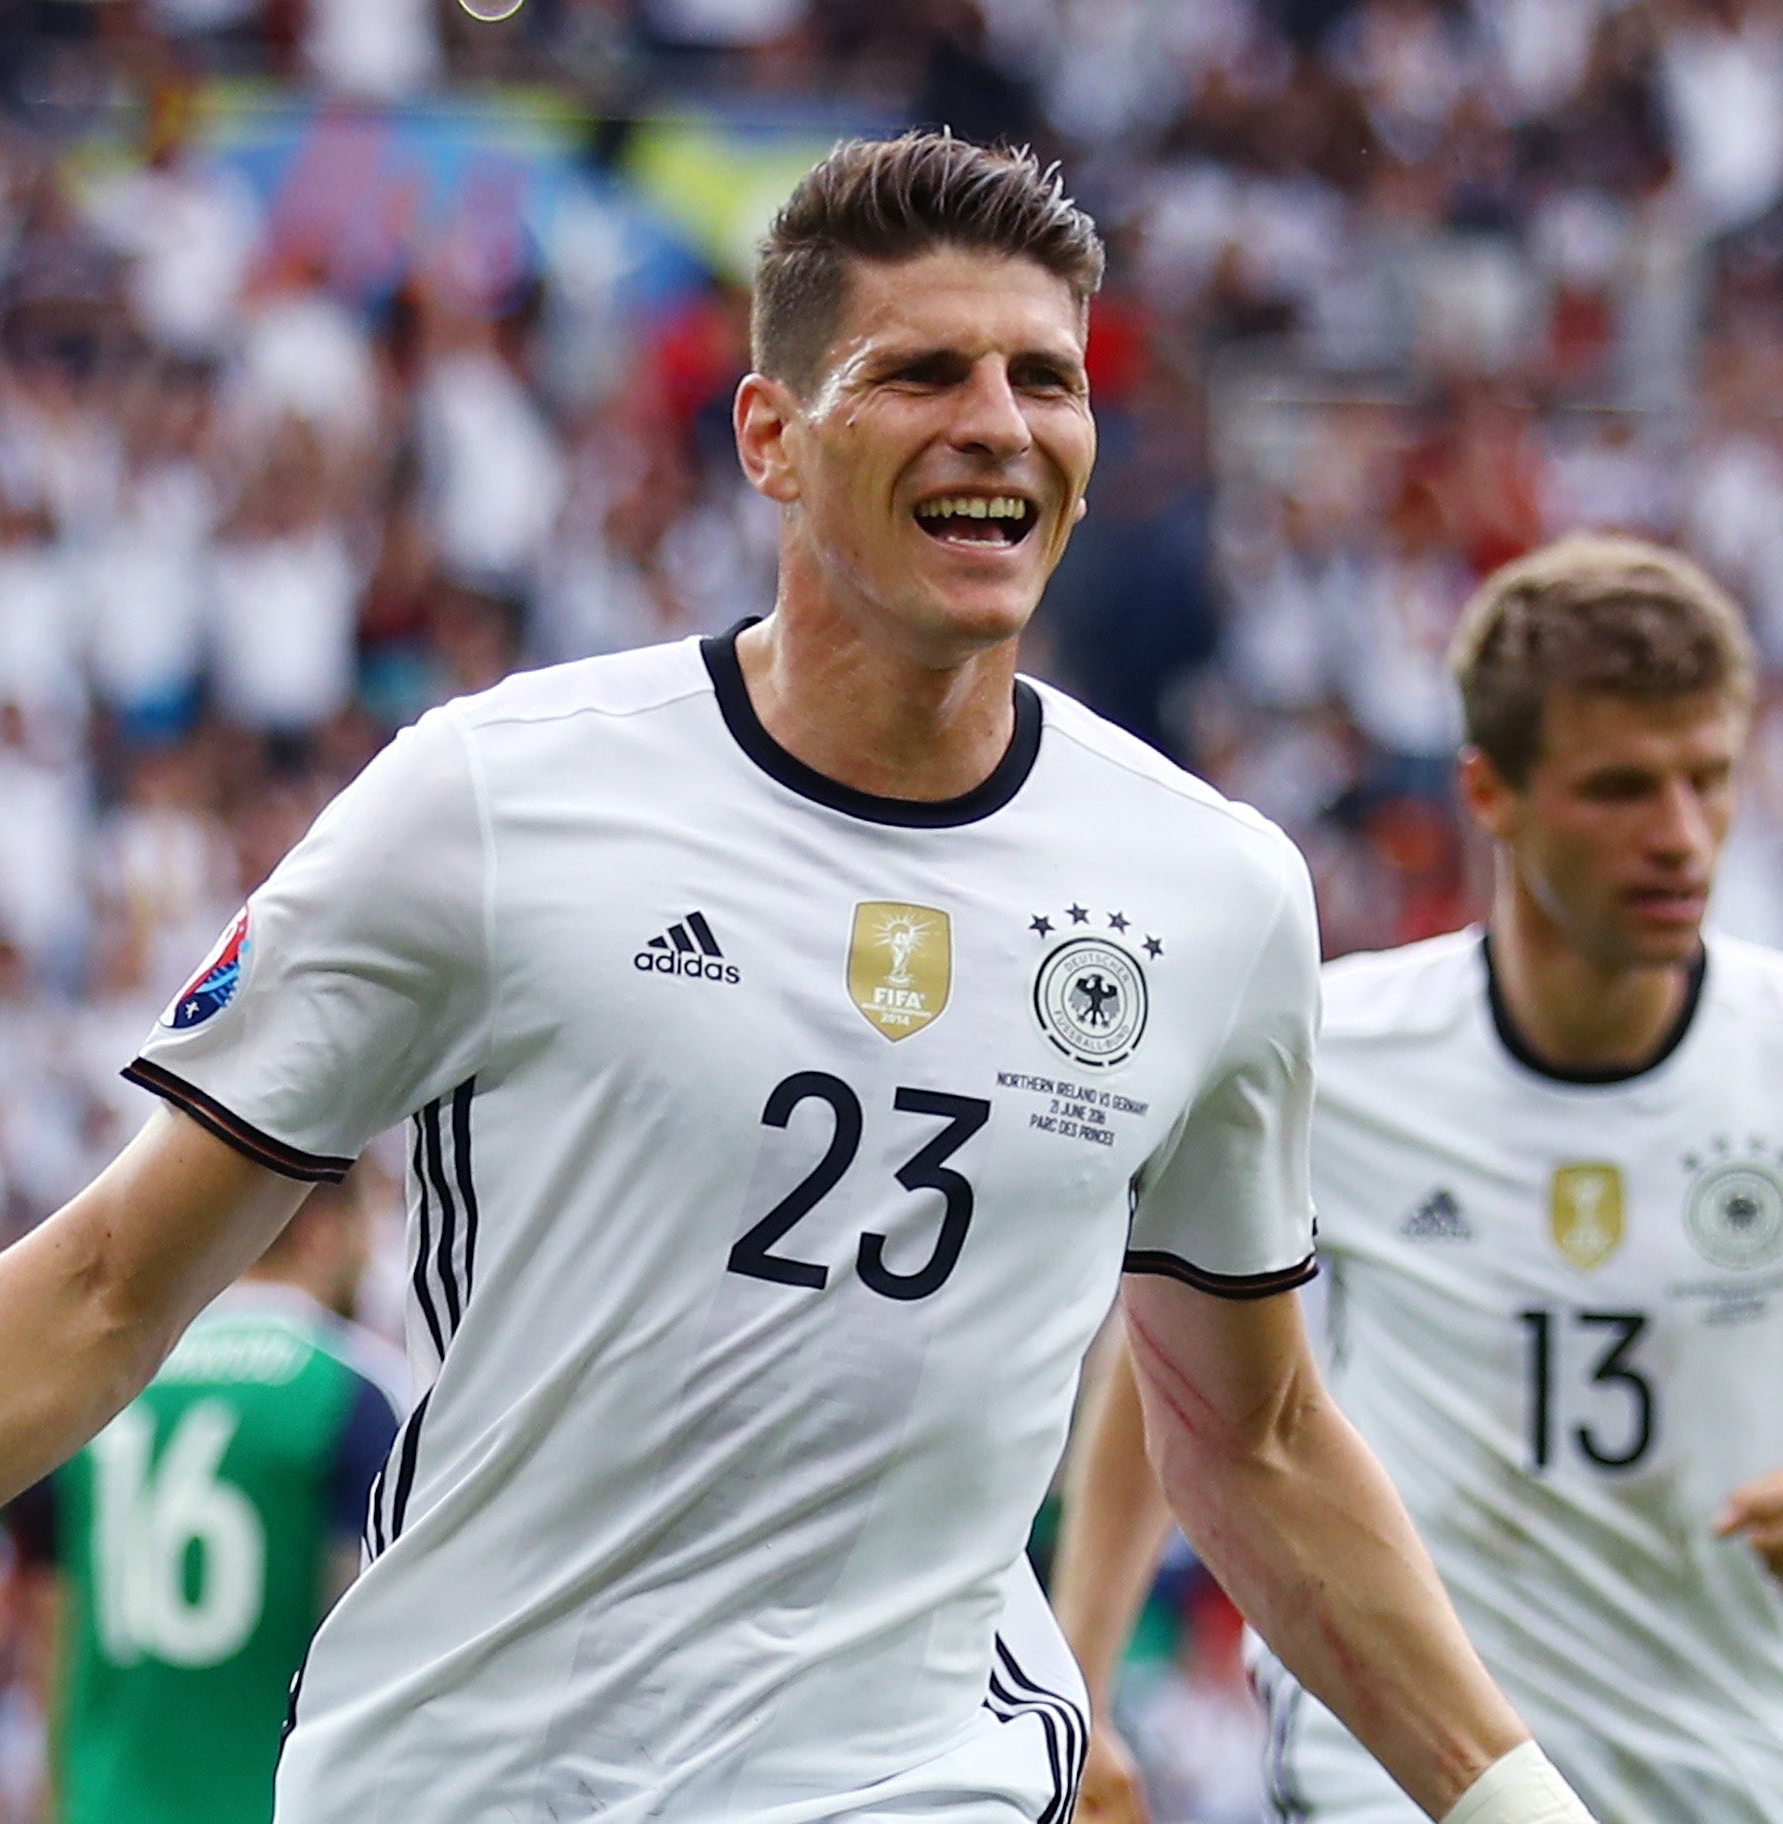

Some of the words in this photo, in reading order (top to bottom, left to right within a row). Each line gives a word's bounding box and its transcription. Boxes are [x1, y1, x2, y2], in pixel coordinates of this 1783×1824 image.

[633, 949, 741, 985] adidas
[1064, 952, 1131, 982] DEUTSCHER
[873, 986, 922, 1010] FIFA
[996, 1071, 1054, 1094] NORTHERN
[1056, 1079, 1098, 1103] IRELAND
[1060, 1102, 1086, 1121] JUNE
[1029, 1113, 1057, 1133] PARC
[1058, 1121, 1077, 1138] DES
[1078, 1125, 1115, 1147] PRINCES
[727, 1070, 991, 1300] 23
[1519, 1310, 1657, 1468] 13
[85, 1396, 269, 1670] 16
